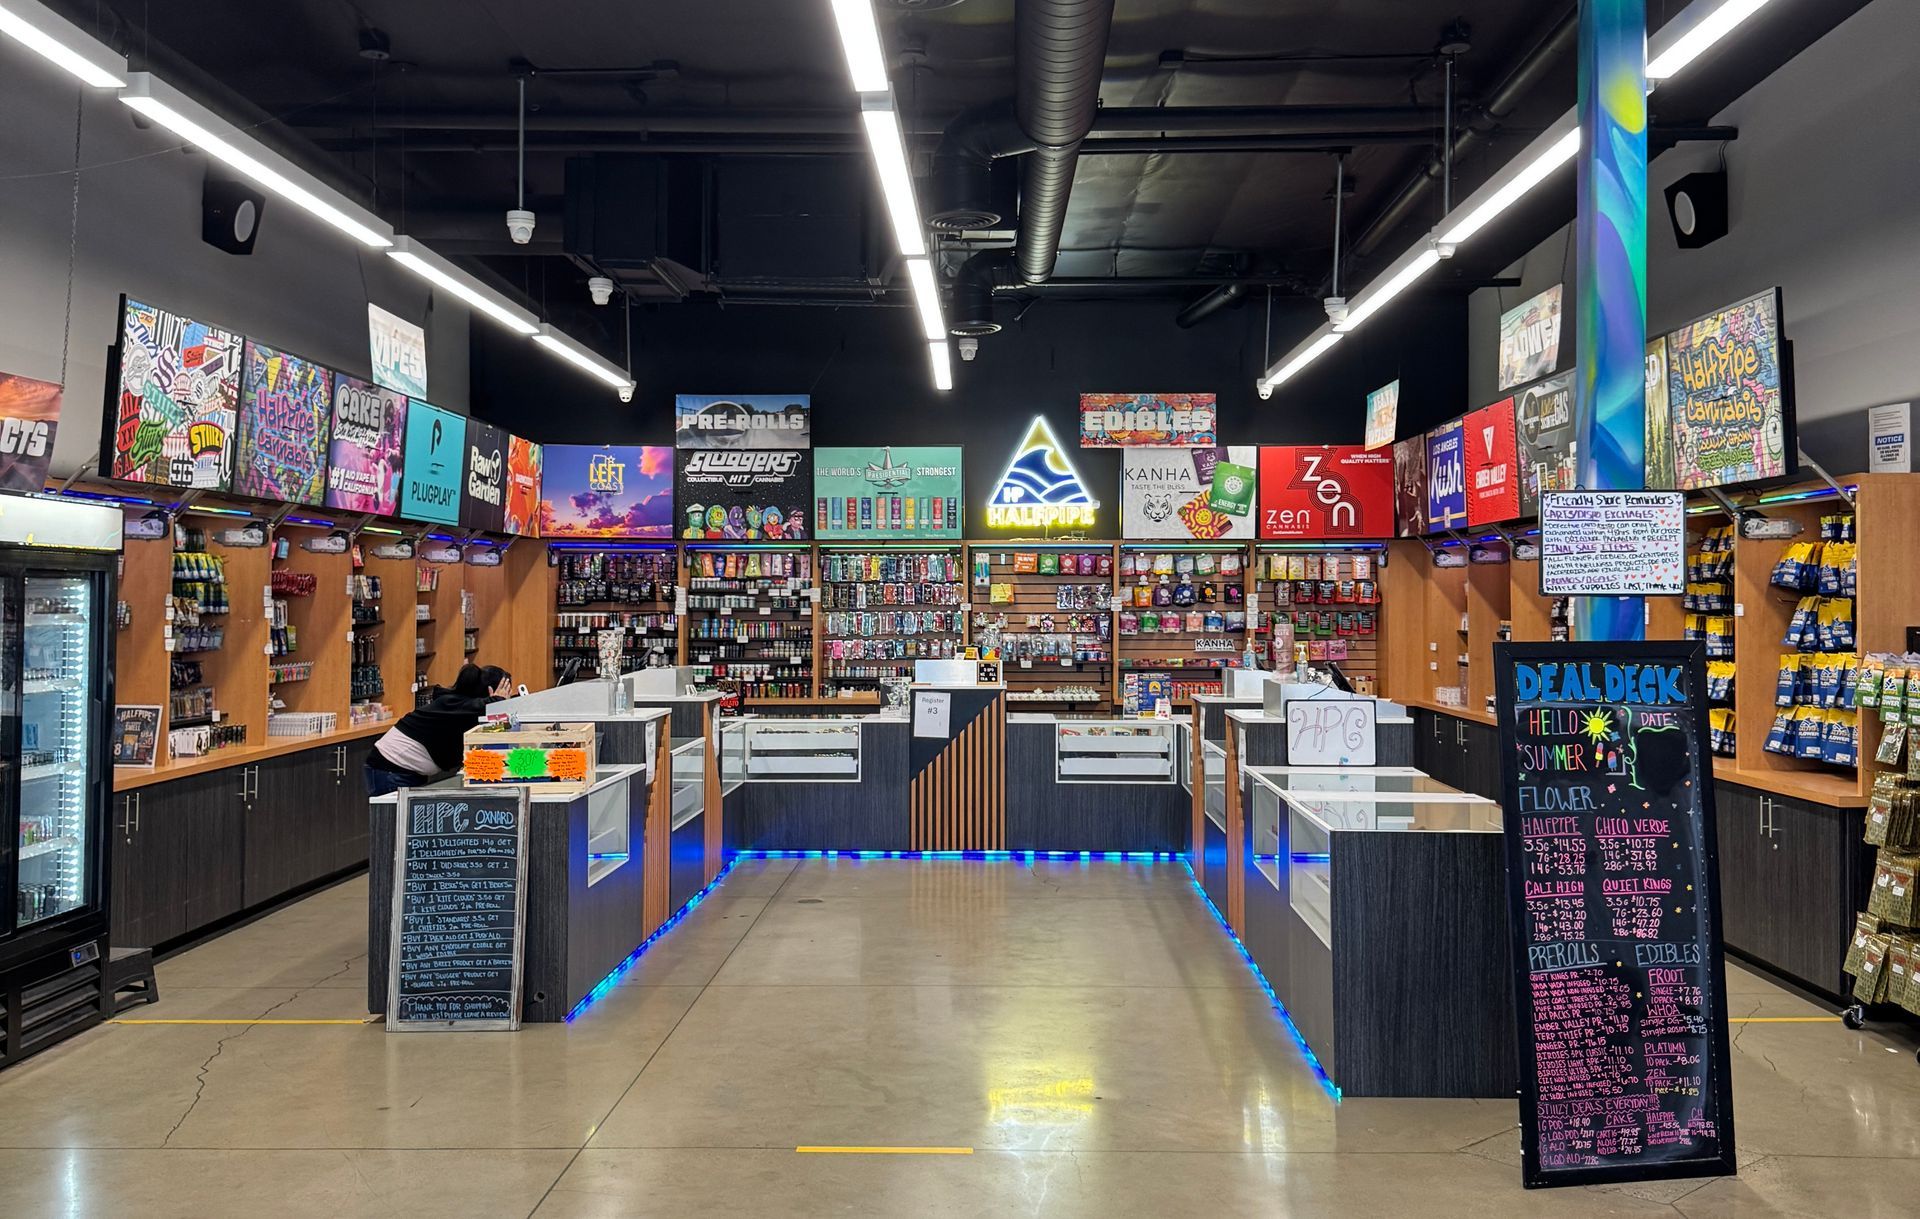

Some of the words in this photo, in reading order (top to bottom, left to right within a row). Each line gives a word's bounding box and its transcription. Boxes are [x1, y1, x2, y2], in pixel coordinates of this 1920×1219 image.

[1504, 312, 1561, 365] FLOWER
[338, 386, 381, 426] CAKE
[683, 414, 804, 430] PRE-ROLLS
[1085, 411, 1212, 431] EDIBLES
[1876, 435, 1902, 444] NOTICE
[470, 446, 492, 477] Raw
[590, 464, 625, 482] LEFT
[816, 468, 829, 476] THE
[916, 466, 956, 476] STRONGEST
[1124, 468, 1191, 480] KANHA
[729, 475, 750, 483] HIT
[469, 472, 500, 506] Garden
[1550, 494, 1593, 506] Friendly
[1597, 495, 1620, 505] Store
[1625, 495, 1673, 505] Reminders
[988, 506, 1095, 526] HALFPIPE
[1545, 545, 1572, 553] FINAL
[1196, 640, 1234, 648] KANHA
[1517, 664, 1600, 700] DEAL
[1605, 664, 1687, 704] DECK
[1530, 710, 1578, 736] HELLO
[1641, 712, 1678, 726] DATE:
[1524, 744, 1587, 771] SUMMER
[1519, 787, 1597, 811] FLOWER
[414, 802, 469, 833] HPC
[476, 810, 513, 825] OXNARD
[1522, 817, 1580, 835] HALFPIPE
[1634, 819, 1670, 833] VERDE
[412, 840, 428, 849] BUY
[412, 862, 427, 870] BUY
[411, 883, 426, 891] BUY
[1525, 881, 1552, 895] CALI
[1557, 881, 1584, 893] HIGH
[1603, 879, 1639, 892] QUIET
[1643, 879, 1672, 890] KINGS
[411, 895, 425, 904] BUY
[409, 916, 423, 925] BUY
[1528, 943, 1600, 970] PREROLLS
[1635, 943, 1700, 965] EDIBLES
[1646, 1004, 1680, 1016] WHOA
[1536, 1050, 1570, 1061] BIRDIES
[1537, 1060, 1566, 1069] BIRDIES
[1537, 1068, 1568, 1077] BIRDIES
[1646, 1068, 1666, 1078] ZEN
[1572, 1101, 1603, 1114] DEALS
[1606, 1113, 1635, 1125] CAKE
